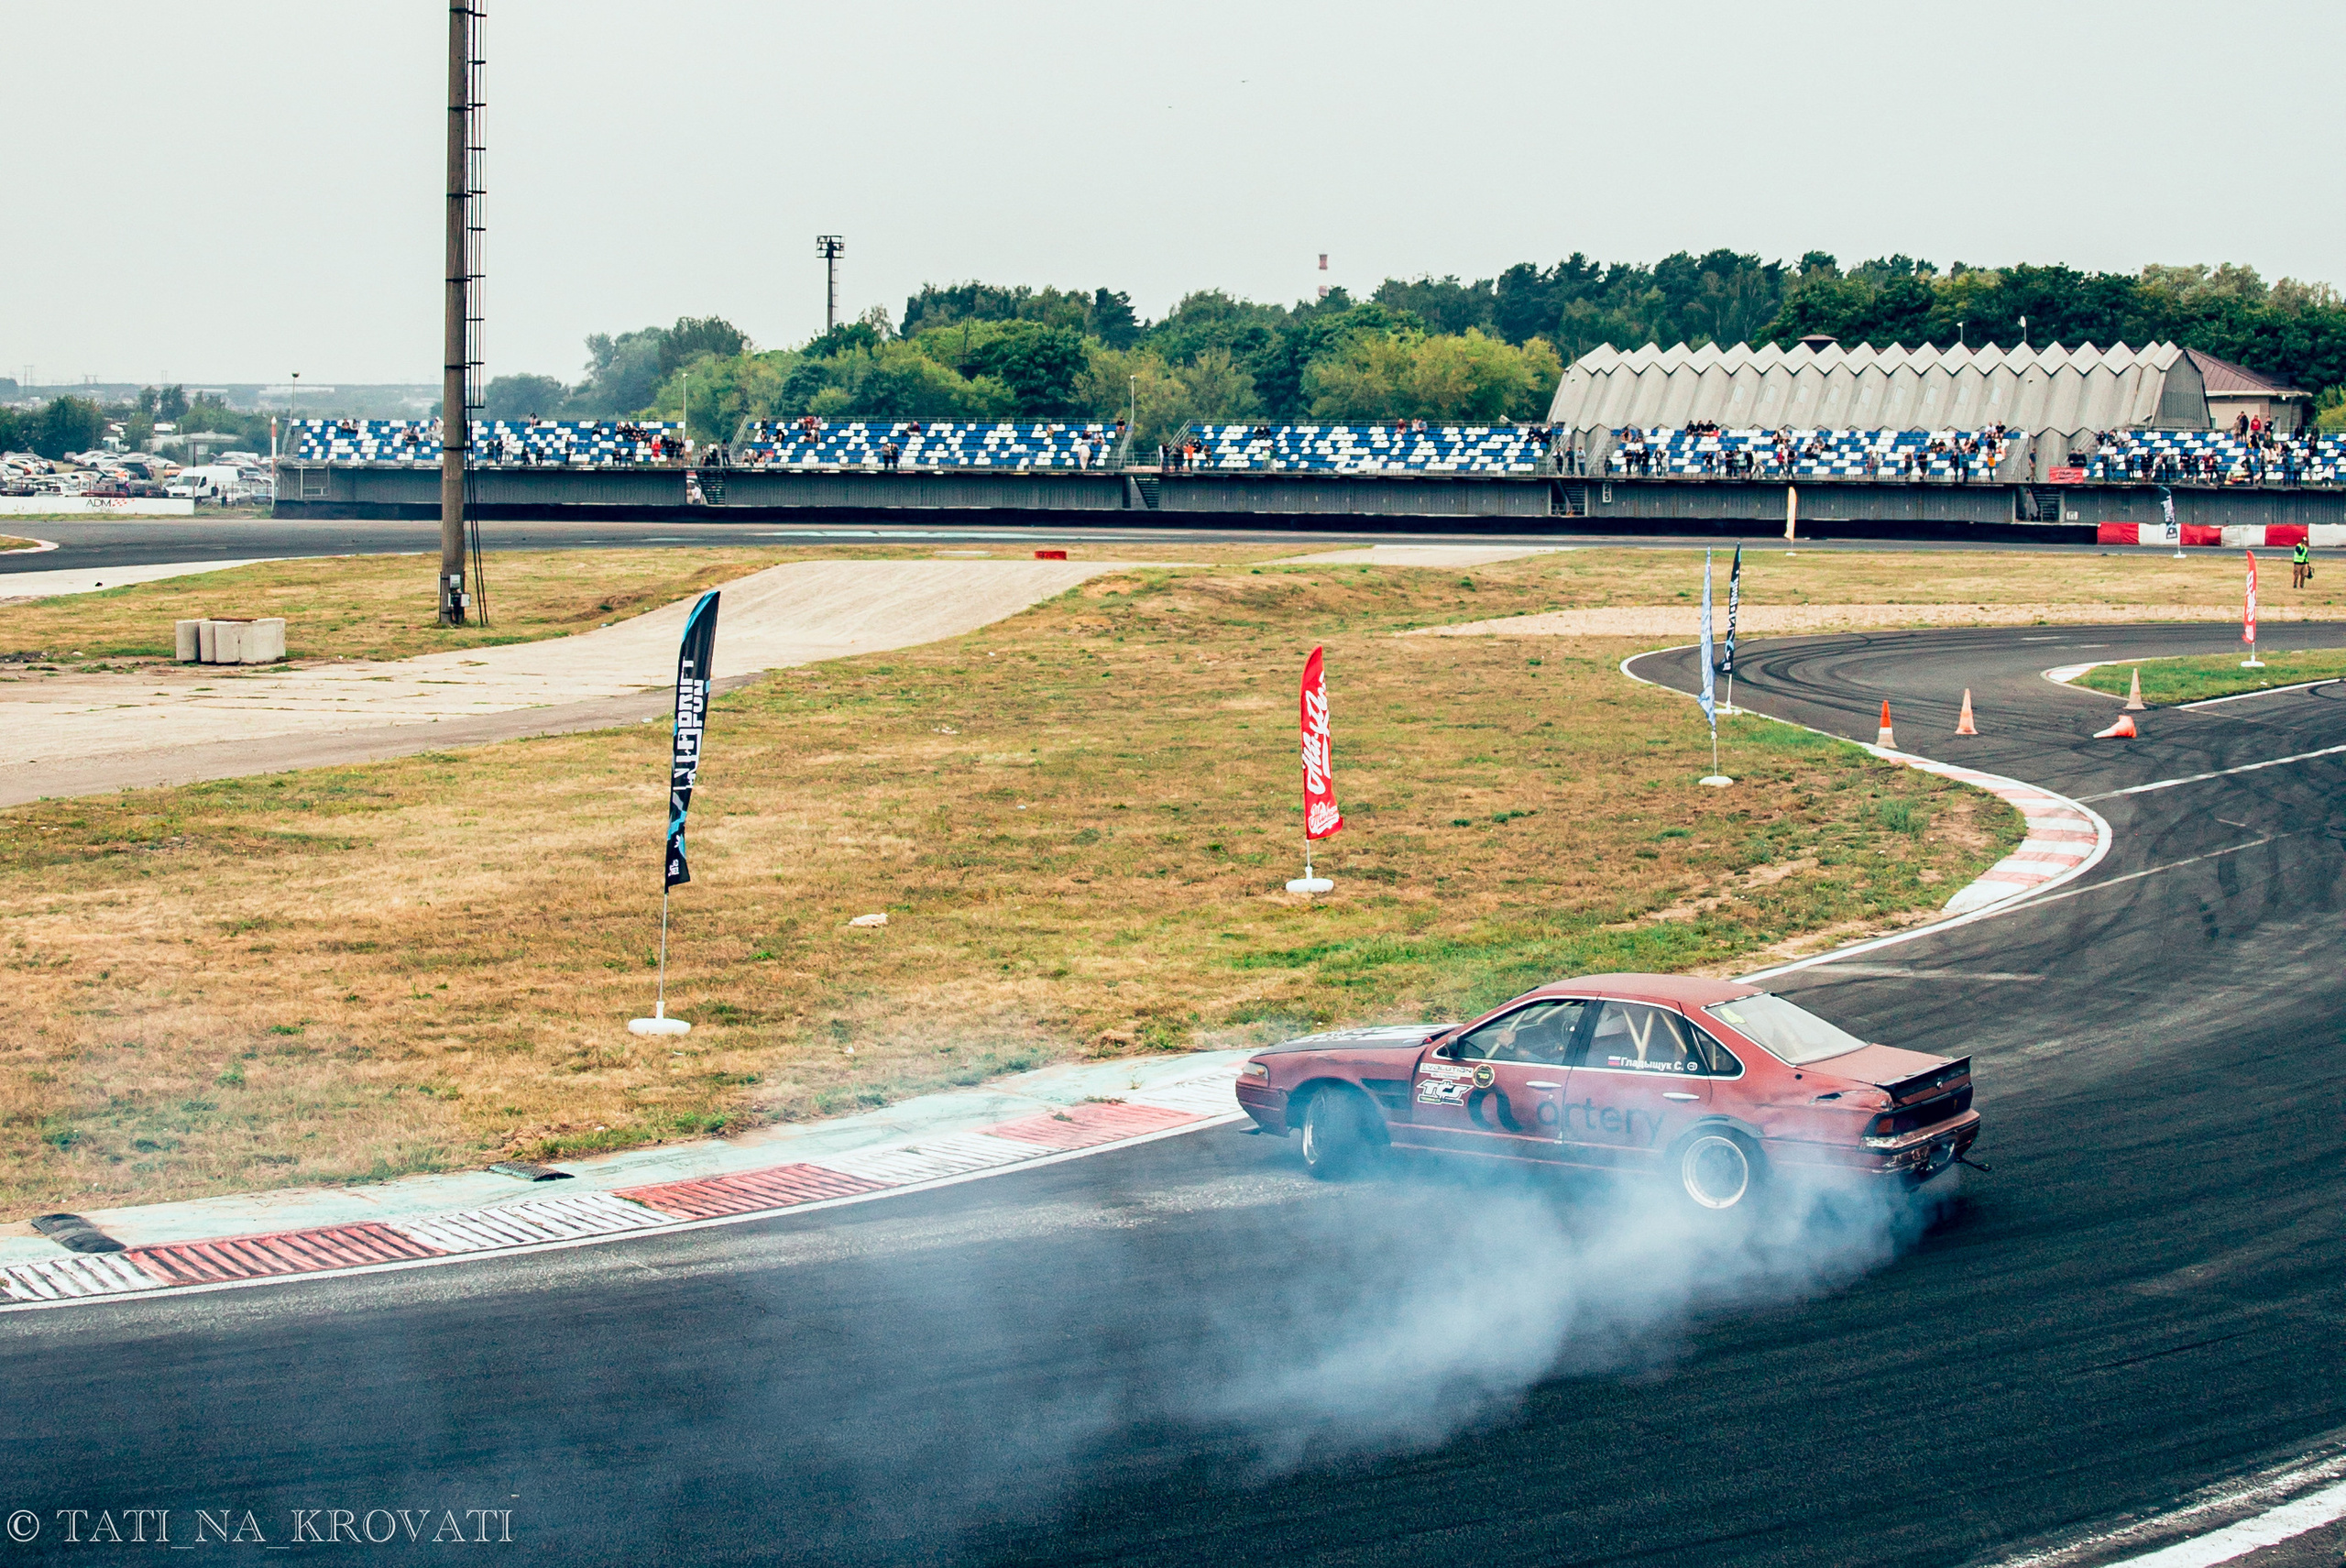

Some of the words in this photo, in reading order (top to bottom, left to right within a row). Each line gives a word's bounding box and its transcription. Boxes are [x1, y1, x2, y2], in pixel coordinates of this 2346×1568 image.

[86, 499, 111, 508] ADM
[677, 656, 695, 728] DRIFT
[692, 679, 704, 728] FUN
[1537, 1098, 1666, 1145] artery
